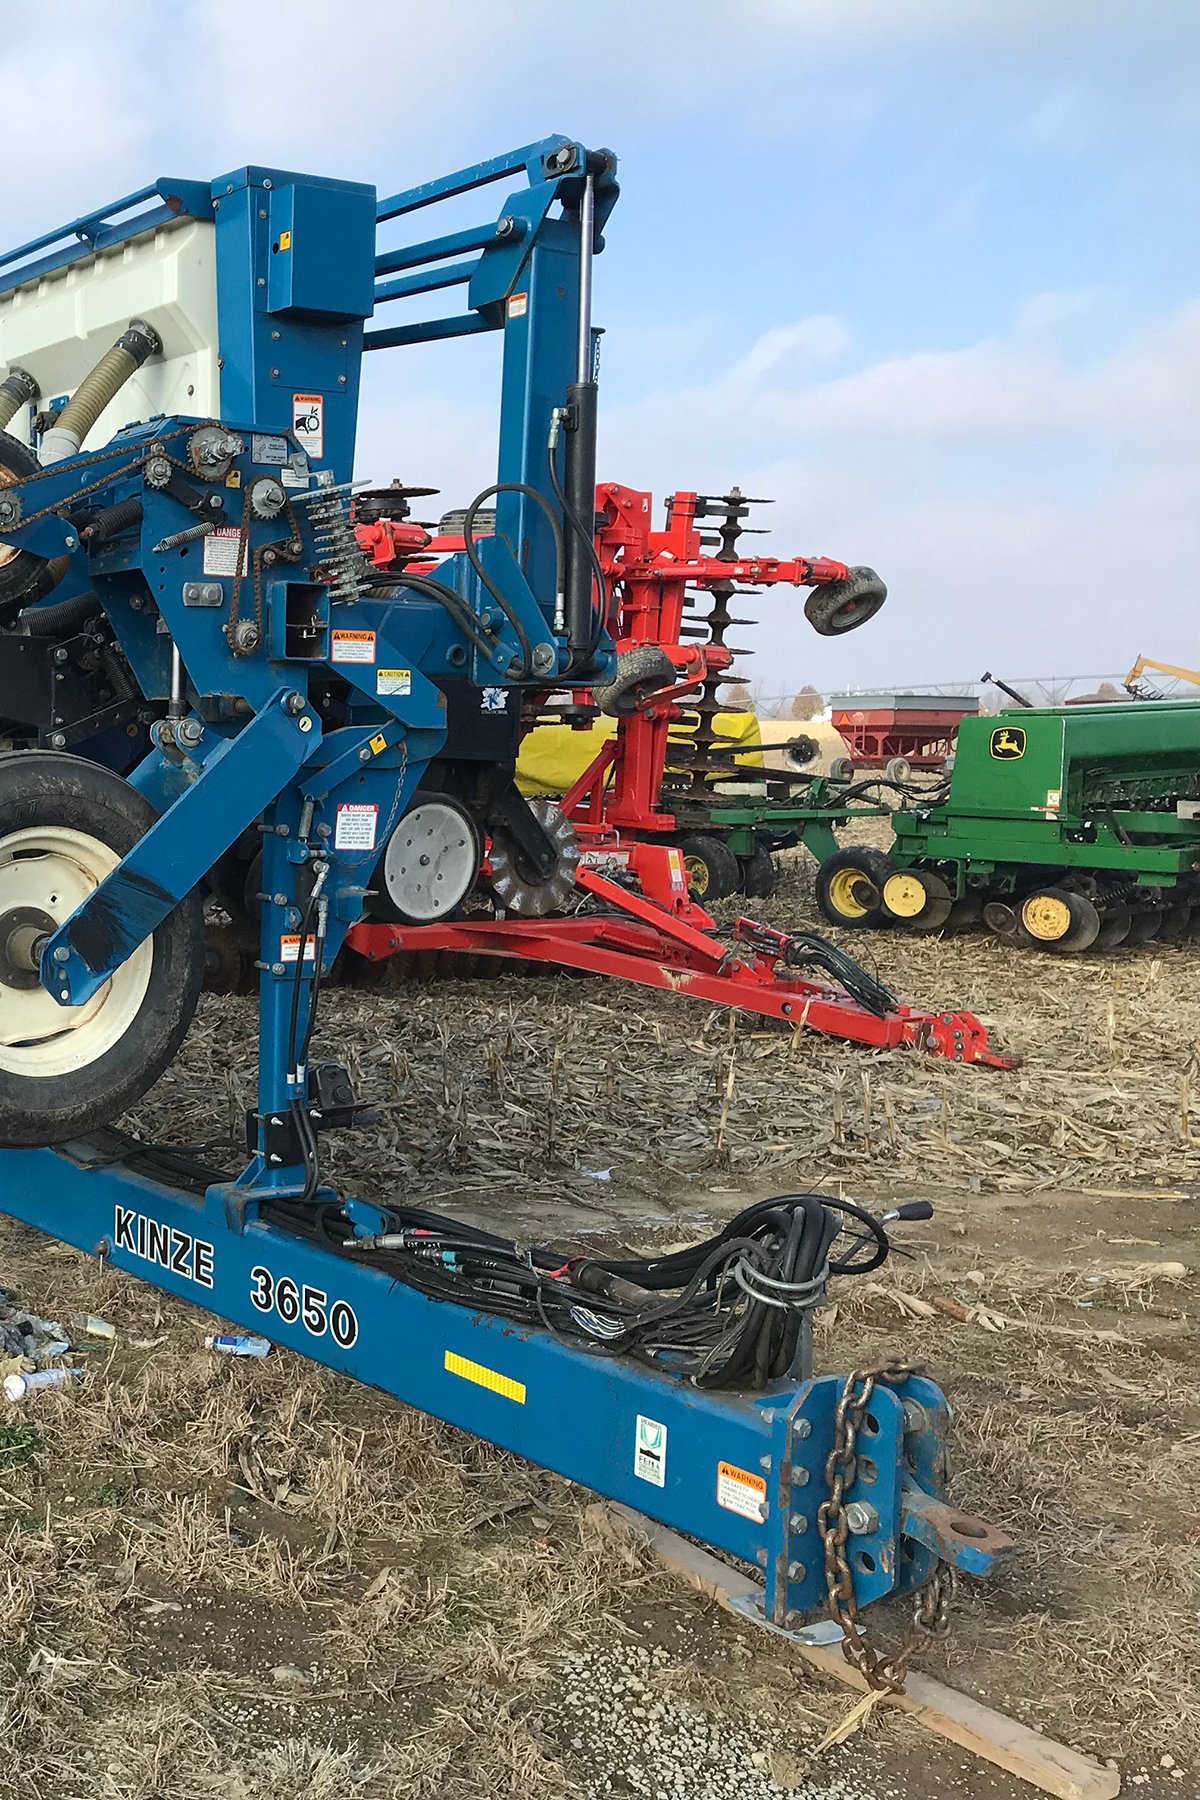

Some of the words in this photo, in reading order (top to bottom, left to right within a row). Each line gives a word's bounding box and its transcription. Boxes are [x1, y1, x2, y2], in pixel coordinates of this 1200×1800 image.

[216, 527, 242, 538] DANGE
[340, 632, 367, 641] WARNING
[349, 804, 375, 812] DANGER
[114, 1204, 214, 1289] KINZE
[250, 1265, 359, 1349] 3650
[729, 1469, 764, 1490] WARNING
